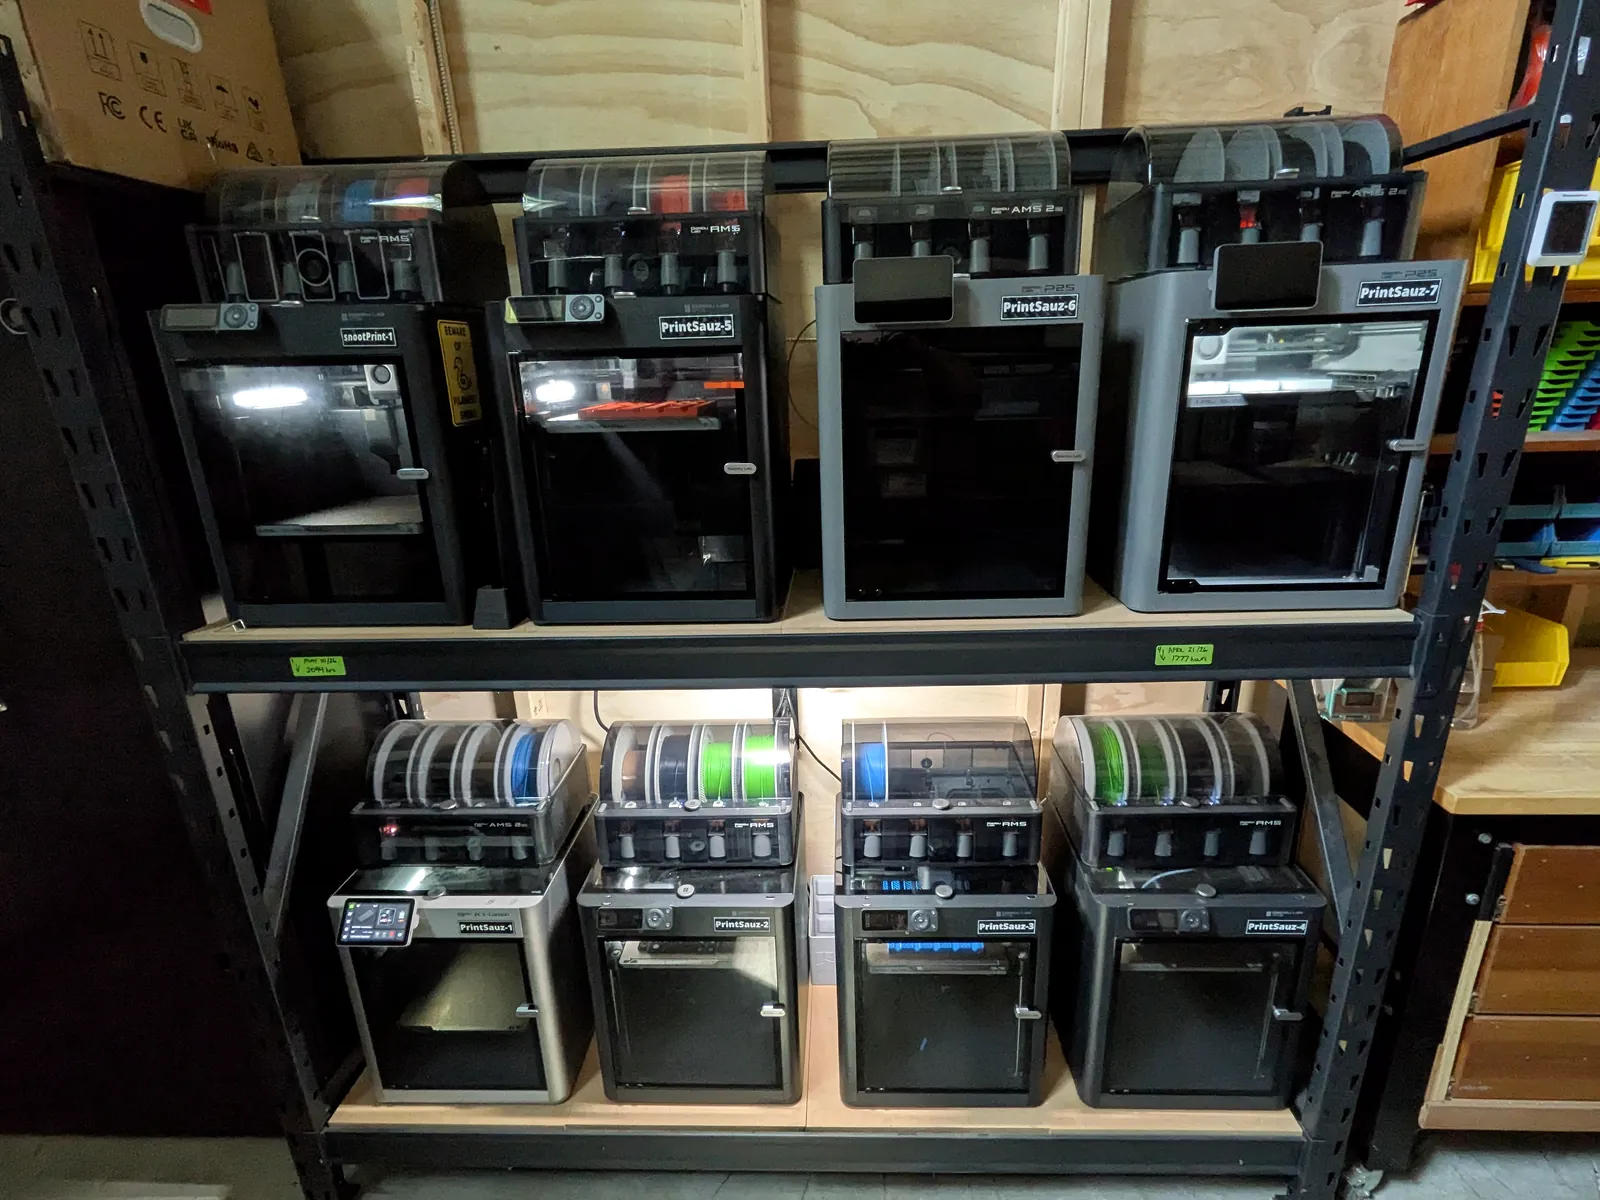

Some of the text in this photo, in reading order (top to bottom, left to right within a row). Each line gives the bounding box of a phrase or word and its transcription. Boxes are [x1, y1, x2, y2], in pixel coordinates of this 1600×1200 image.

[139, 106, 167, 133] CE
[1011, 204, 1043, 214] AMS
[710, 224, 741, 233] AMS
[379, 235, 410, 243] AMS
[1043, 283, 1076, 293] P2S
[1359, 284, 1440, 299] PrintSauz-7
[1002, 300, 1077, 314] PrintSauz-6
[660, 319, 733, 333] PrintSauz-5
[342, 331, 394, 342] snootPrint-1
[460, 923, 514, 932] PrintSauz-1
[715, 920, 770, 929] PrintSauz-2
[979, 922, 1035, 931] PrintSauz-3
[1247, 922, 1307, 931] PrintSauz-4
